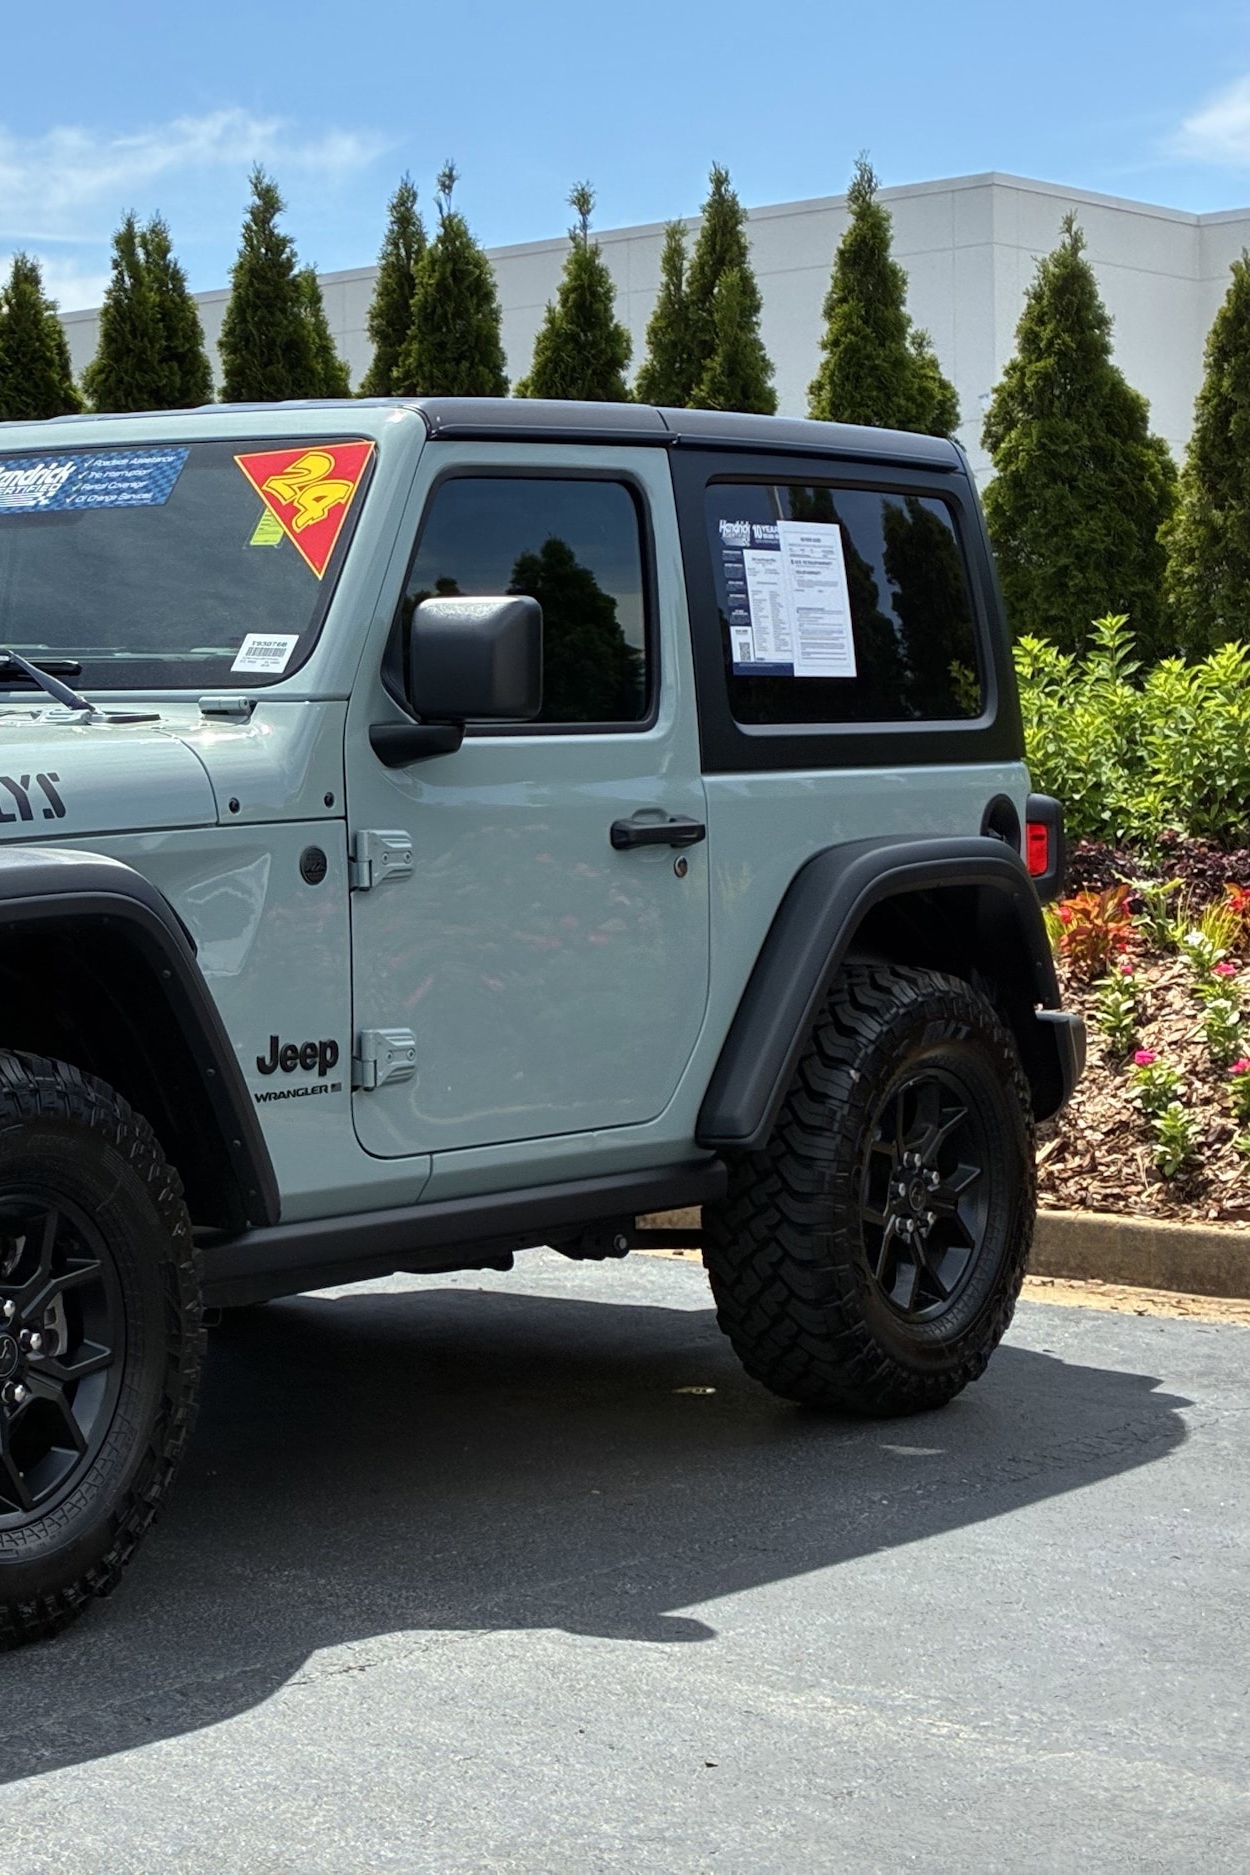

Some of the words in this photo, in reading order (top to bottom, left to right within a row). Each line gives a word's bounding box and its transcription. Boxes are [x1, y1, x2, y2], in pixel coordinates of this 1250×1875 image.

[262, 450, 355, 534] 24
[256, 1034, 340, 1077] Jeep
[254, 1084, 329, 1103] WRANGLER
